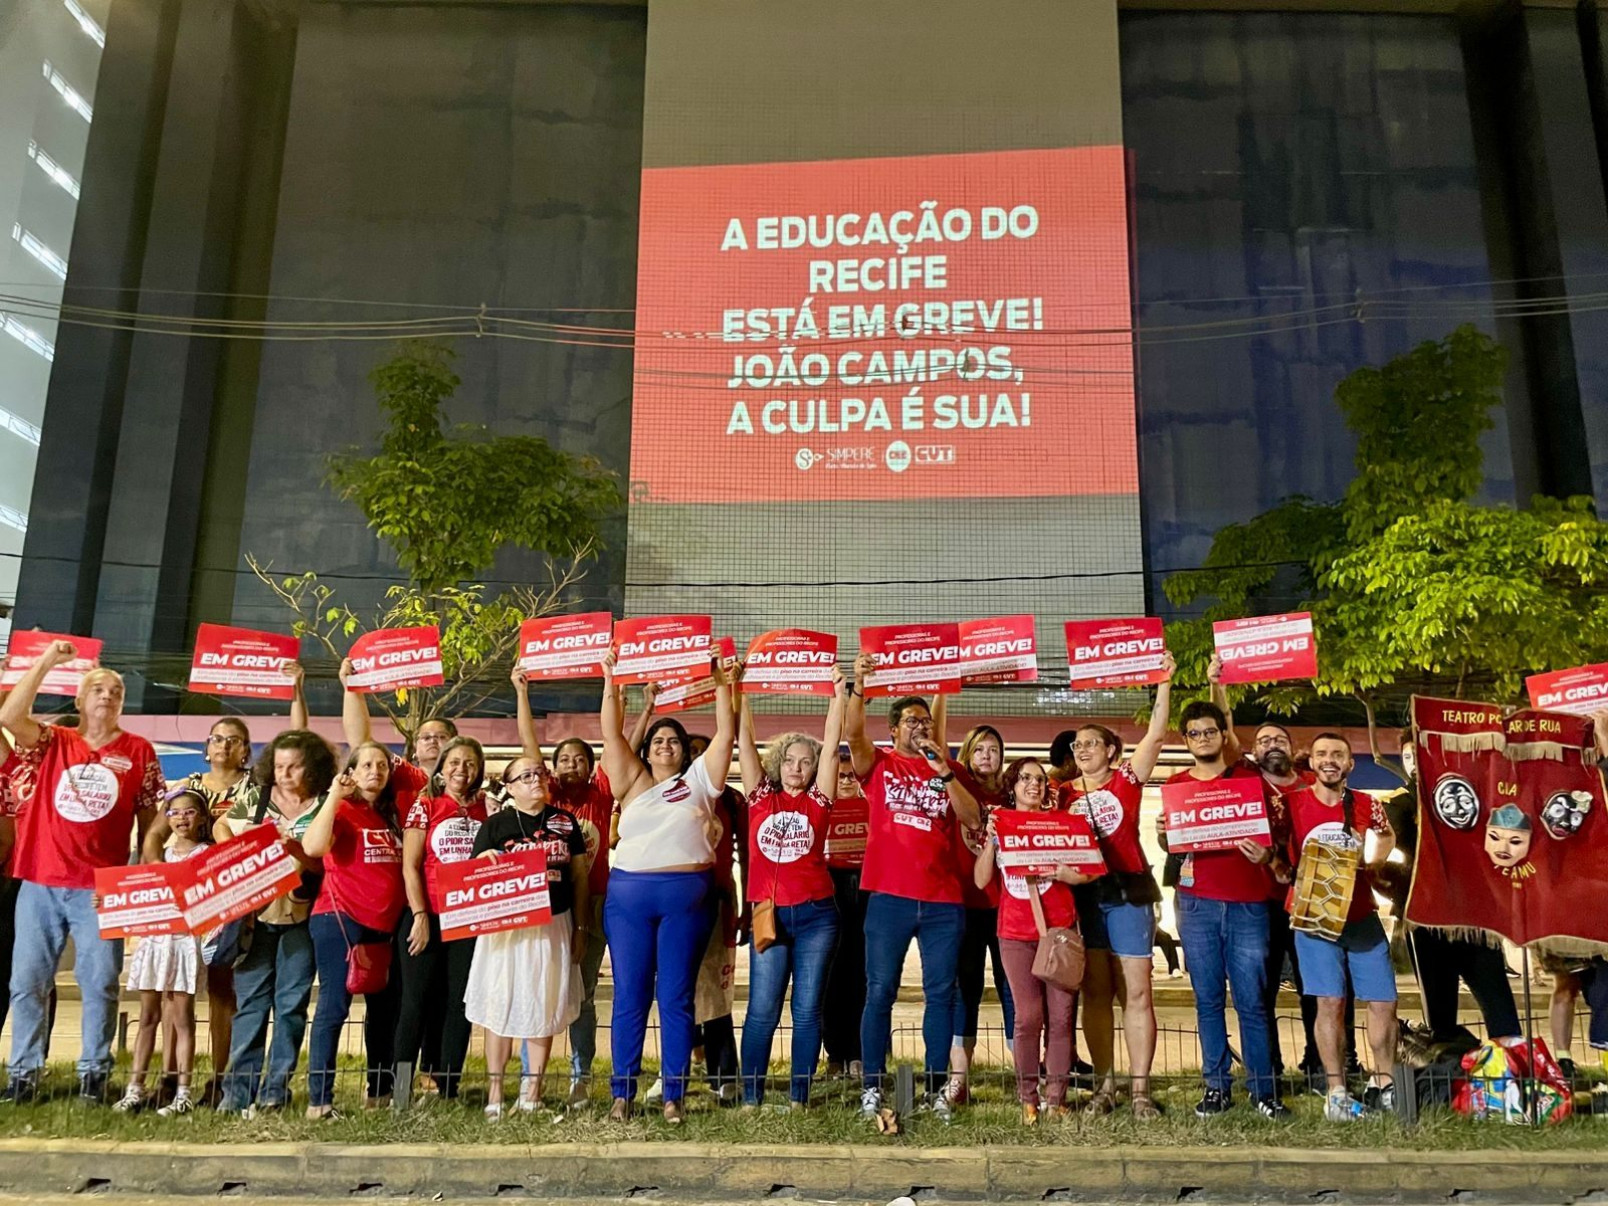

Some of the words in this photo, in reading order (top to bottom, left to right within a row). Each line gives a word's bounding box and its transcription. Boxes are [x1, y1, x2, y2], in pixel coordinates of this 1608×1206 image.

[720, 218, 748, 251] A
[757, 200, 972, 254] EDUCAÇÃO
[981, 205, 1039, 240] DO
[809, 255, 948, 293] RECIFE
[723, 297, 820, 342] ESTÁ
[828, 304, 886, 339] EM
[895, 298, 1043, 338] GREVE!
[728, 347, 829, 388] JOÃO
[838, 346, 1024, 386] CAMPOS,
[726, 401, 754, 435] A
[761, 398, 891, 434] CULPA
[901, 388, 924, 430] É
[933, 393, 1031, 428] SUA!
[525, 639, 550, 653] EM
[553, 632, 610, 650] GREVE!
[619, 642, 645, 656] EM
[649, 635, 711, 652] GREVE!
[960, 646, 971, 657] M
[974, 638, 1032, 656] GREVE!
[1075, 645, 1100, 660] EM
[1104, 638, 1163, 656] GREVE!
[1282, 637, 1309, 652] EM
[200, 653, 229, 666] EM
[351, 655, 377, 671] EM
[379, 647, 438, 666] GREVE!
[747, 652, 772, 664] EM
[775, 651, 835, 663] GREVE!
[871, 652, 894, 666] EM
[898, 646, 958, 664] GREVE!
[1537, 691, 1562, 706] EM
[1442, 710, 1485, 724] TEATRO
[1540, 719, 1561, 733] RUA
[1497, 781, 1517, 796] CIA
[1170, 810, 1196, 826] EM
[1200, 802, 1262, 820] GREVE!
[364, 848, 396, 856] CENTRA
[439, 847, 450, 855] EM
[1004, 835, 1029, 848] EM
[1032, 835, 1090, 847] GREVE!
[183, 878, 215, 906] EM
[217, 839, 284, 887] GREVE!
[446, 887, 474, 907] EM
[478, 872, 546, 899] GREVE!
[104, 893, 127, 908] EM
